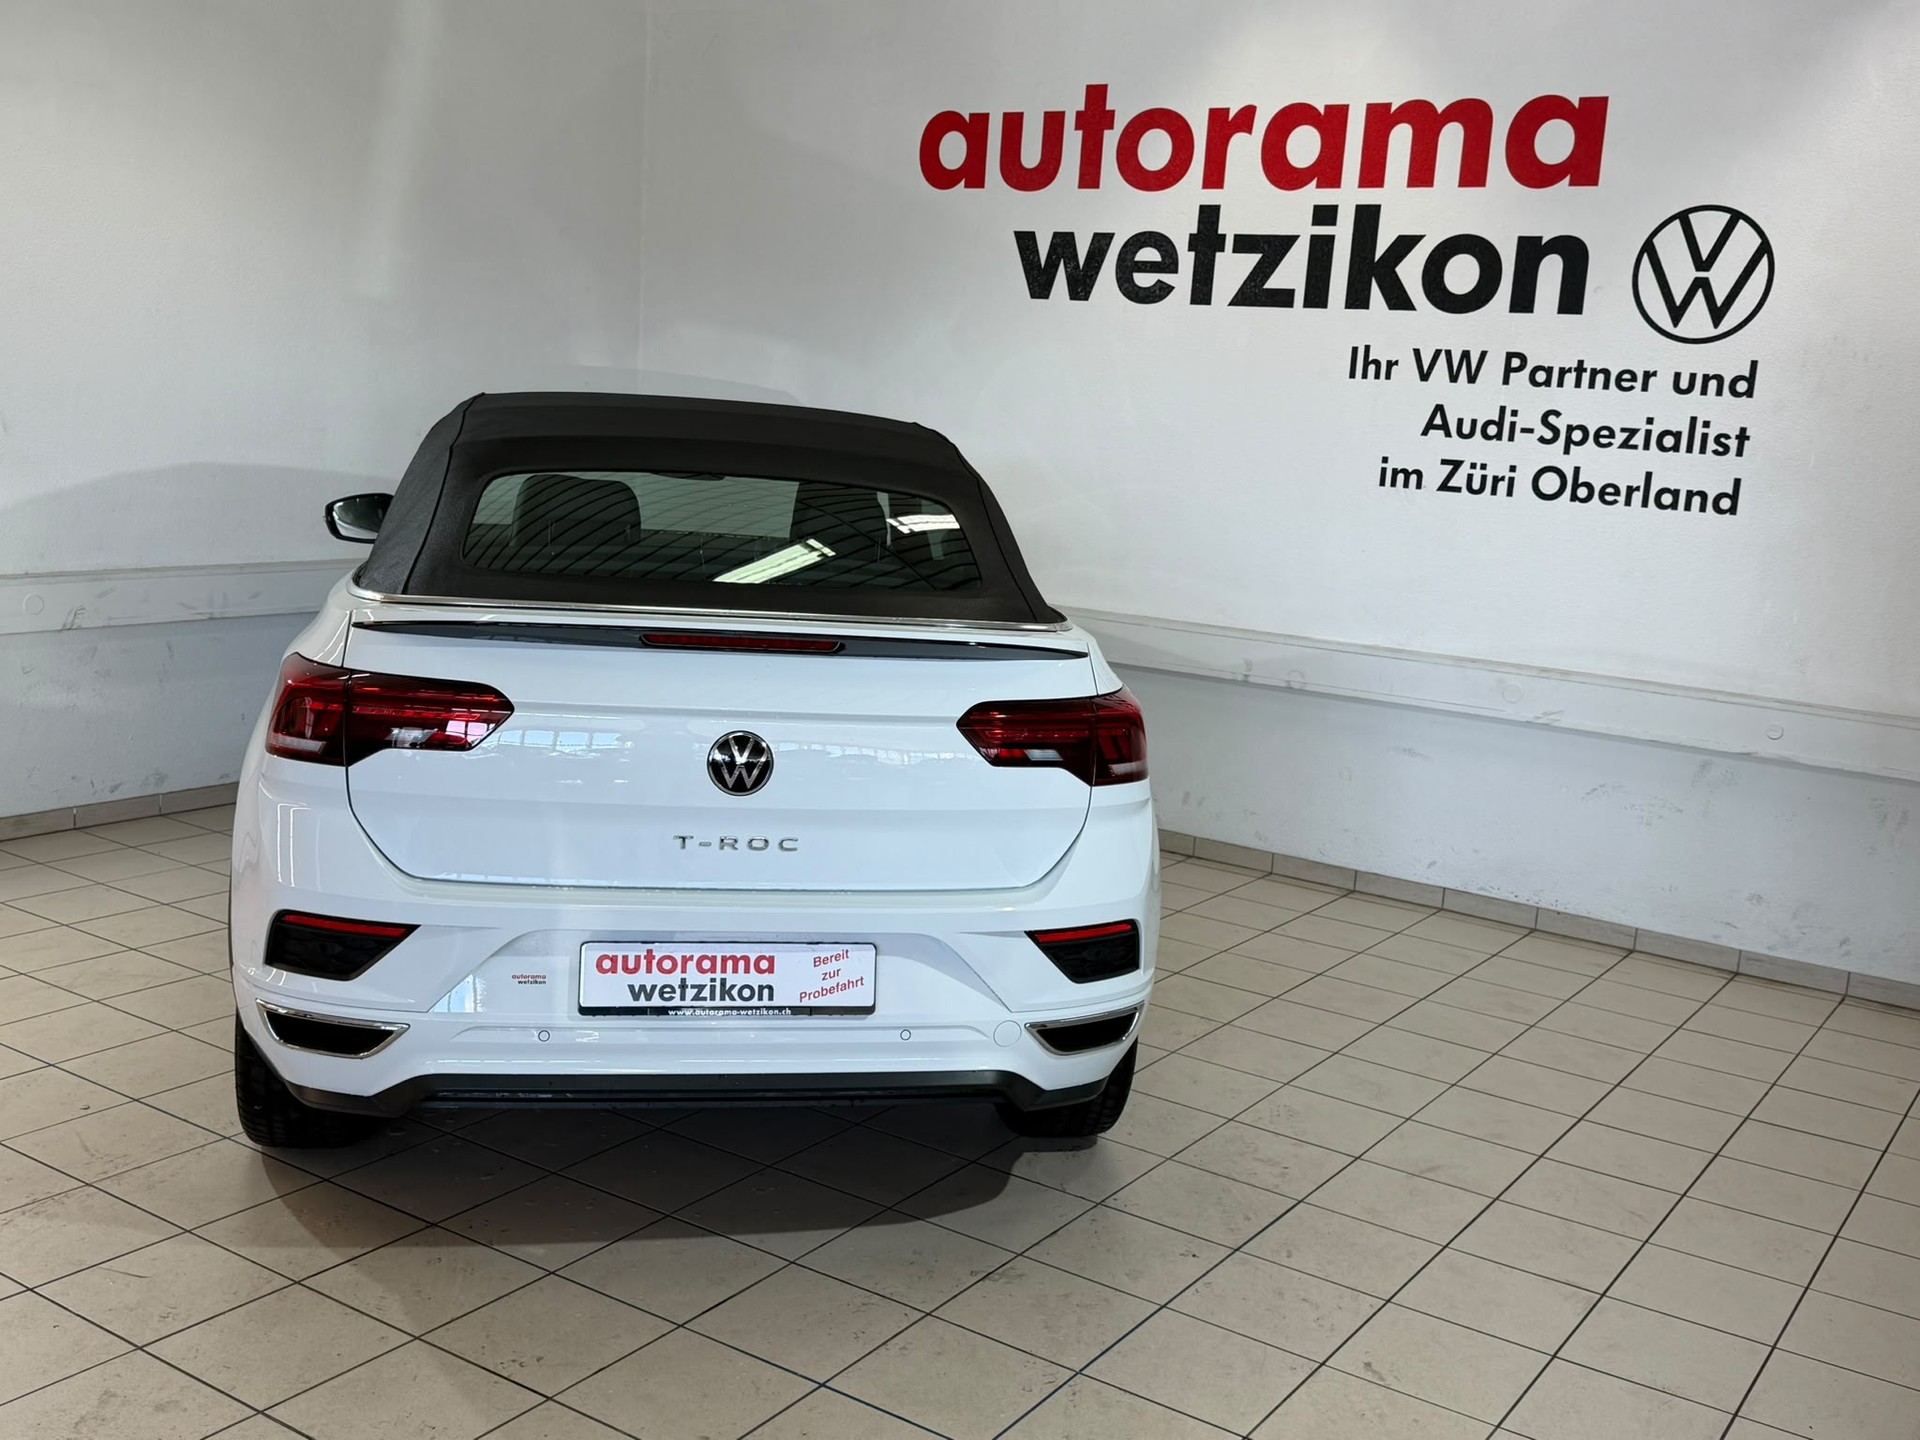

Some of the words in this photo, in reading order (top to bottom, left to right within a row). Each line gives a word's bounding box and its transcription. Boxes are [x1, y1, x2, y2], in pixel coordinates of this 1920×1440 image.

[919, 84, 1609, 192] autorama
[1014, 205, 1590, 316] wetzikon
[1348, 345, 1399, 382] Ihr
[1412, 349, 1488, 385] VW
[1502, 352, 1657, 395] Partner
[1671, 360, 1758, 399] und
[1421, 404, 1751, 459] Audi-Spezialist
[1378, 457, 1424, 490] im
[1436, 460, 1516, 499] Züri
[1531, 466, 1741, 516] Oberland
[673, 835, 799, 852] T-ROC
[595, 949, 775, 975] autorama
[813, 949, 850, 969] Bereit
[821, 967, 842, 981] zur
[627, 978, 775, 1002] wetzikon
[799, 976, 865, 1003] Probefahrt
[668, 1007, 791, 1016] www.autorama-wetzikon.ch
